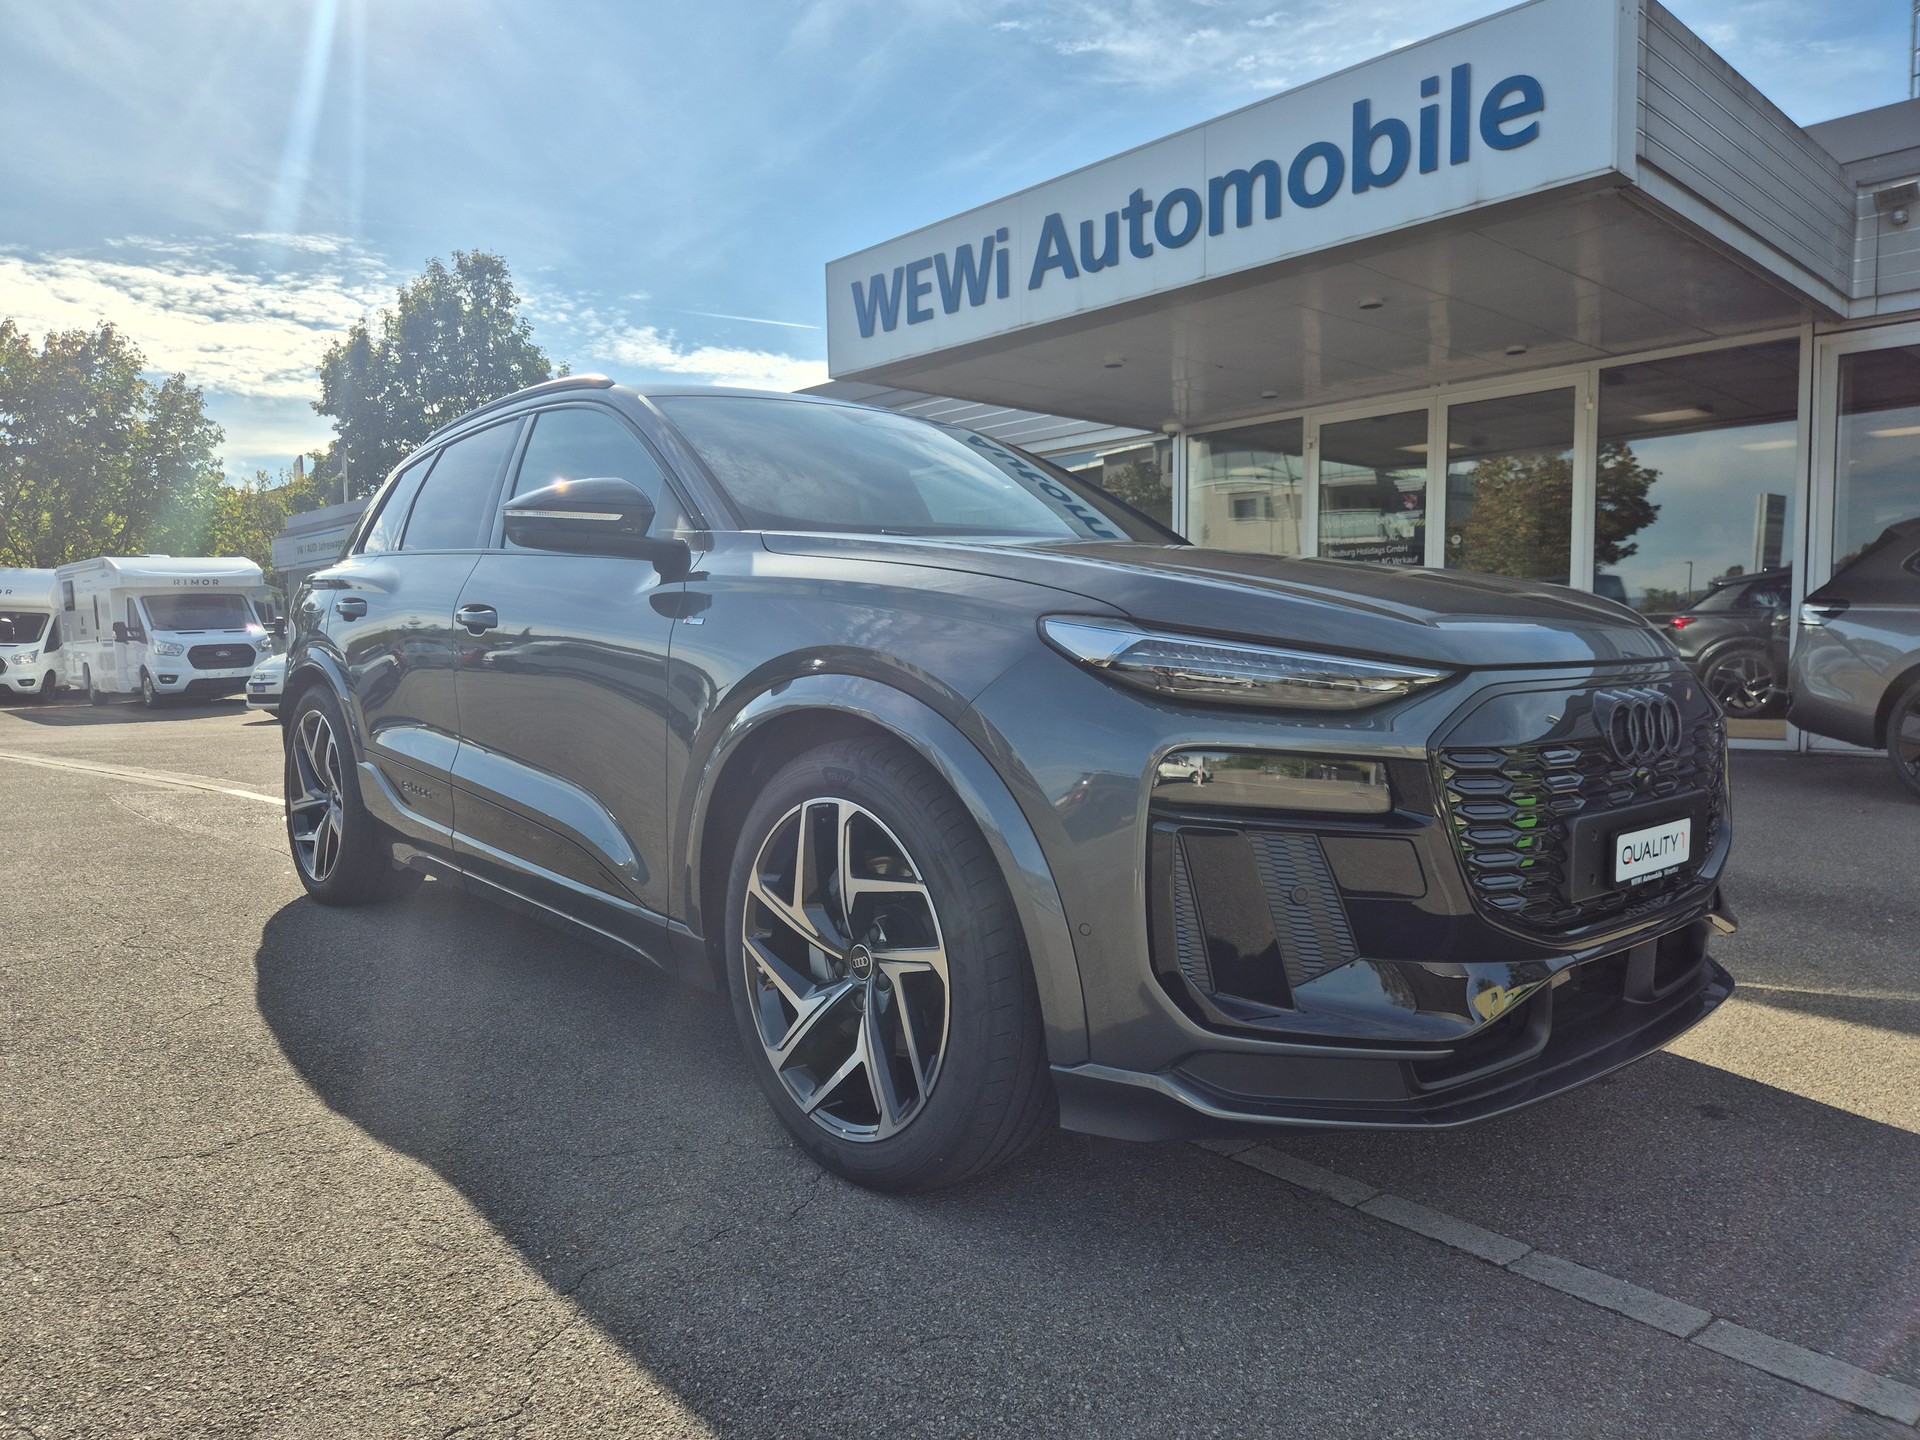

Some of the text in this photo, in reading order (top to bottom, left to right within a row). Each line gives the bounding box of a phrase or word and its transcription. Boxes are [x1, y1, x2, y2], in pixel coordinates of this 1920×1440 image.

[851, 62, 1545, 338] WEWi Automobile
[1324, 518, 1375, 529] Willkommen
[1328, 544, 1408, 558] Neuburg Holidays GmbH
